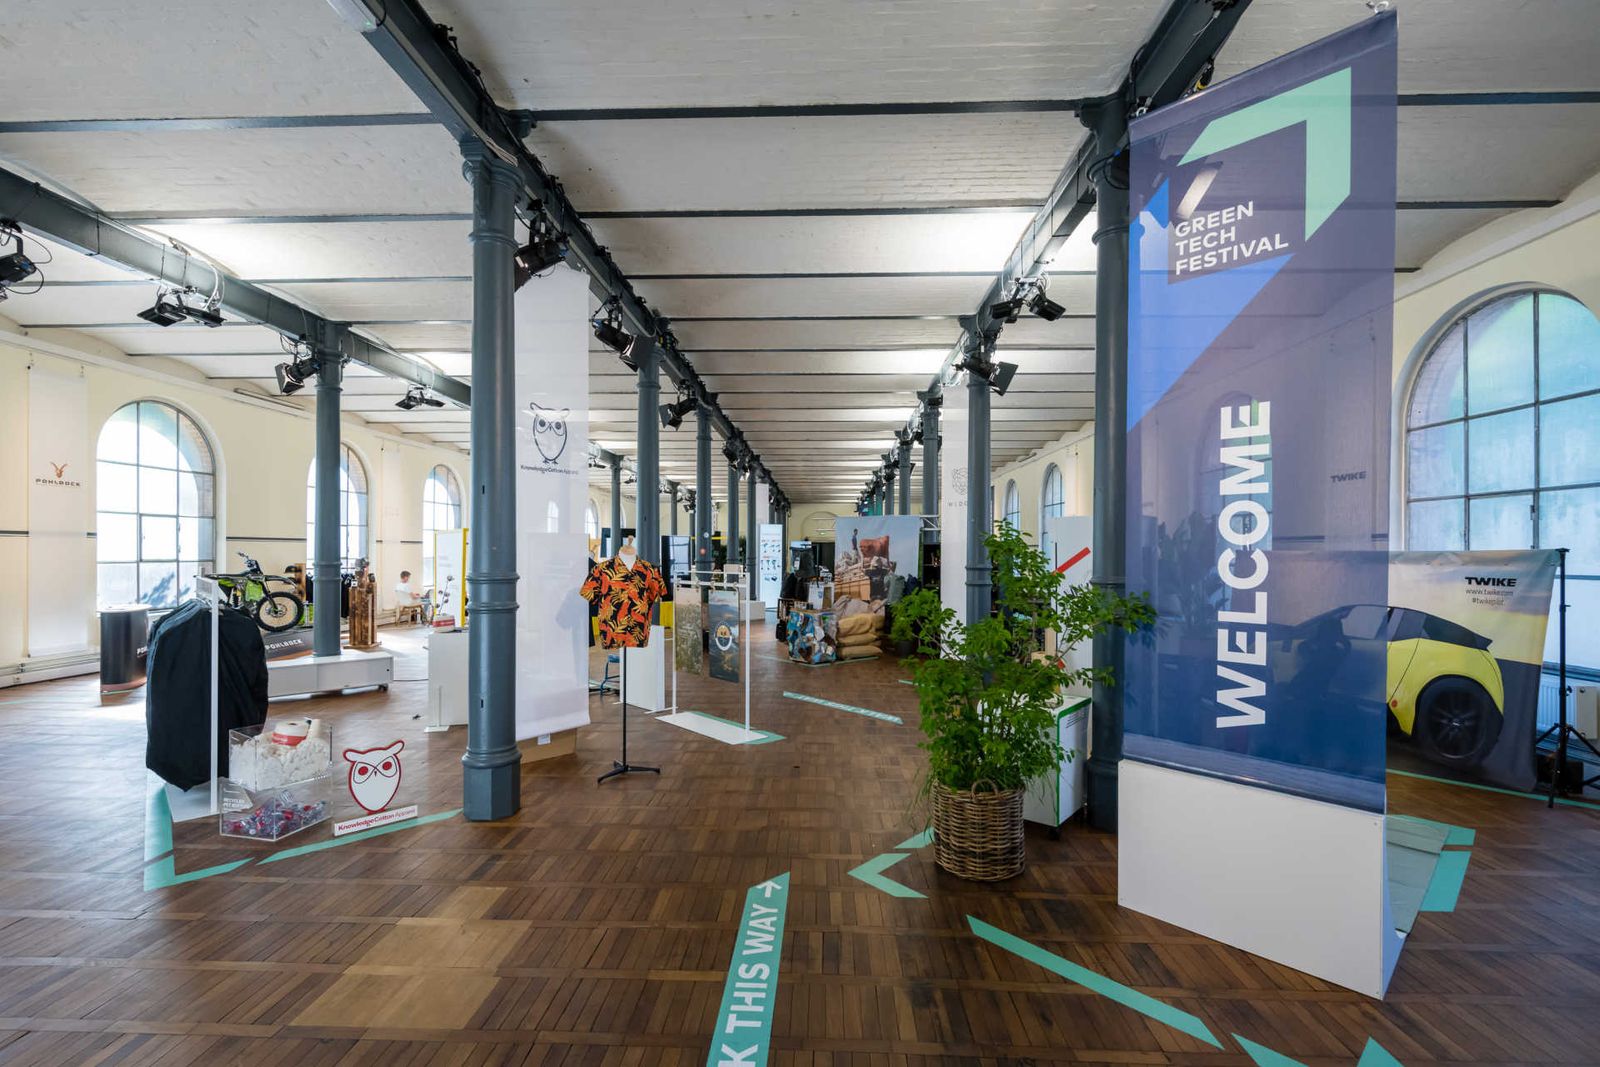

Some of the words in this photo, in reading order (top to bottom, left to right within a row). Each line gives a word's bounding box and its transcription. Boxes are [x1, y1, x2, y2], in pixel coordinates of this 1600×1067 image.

[1175, 200, 1254, 237] GREEN
[1175, 226, 1236, 256] TECH
[1175, 233, 1289, 276] FESTIVAL
[1330, 470, 1367, 482] TWIKE
[1216, 401, 1271, 728] WELCOME
[1464, 576, 1518, 587] TWIKE
[742, 903, 779, 955] WAY
[725, 963, 771, 1034] THIS
